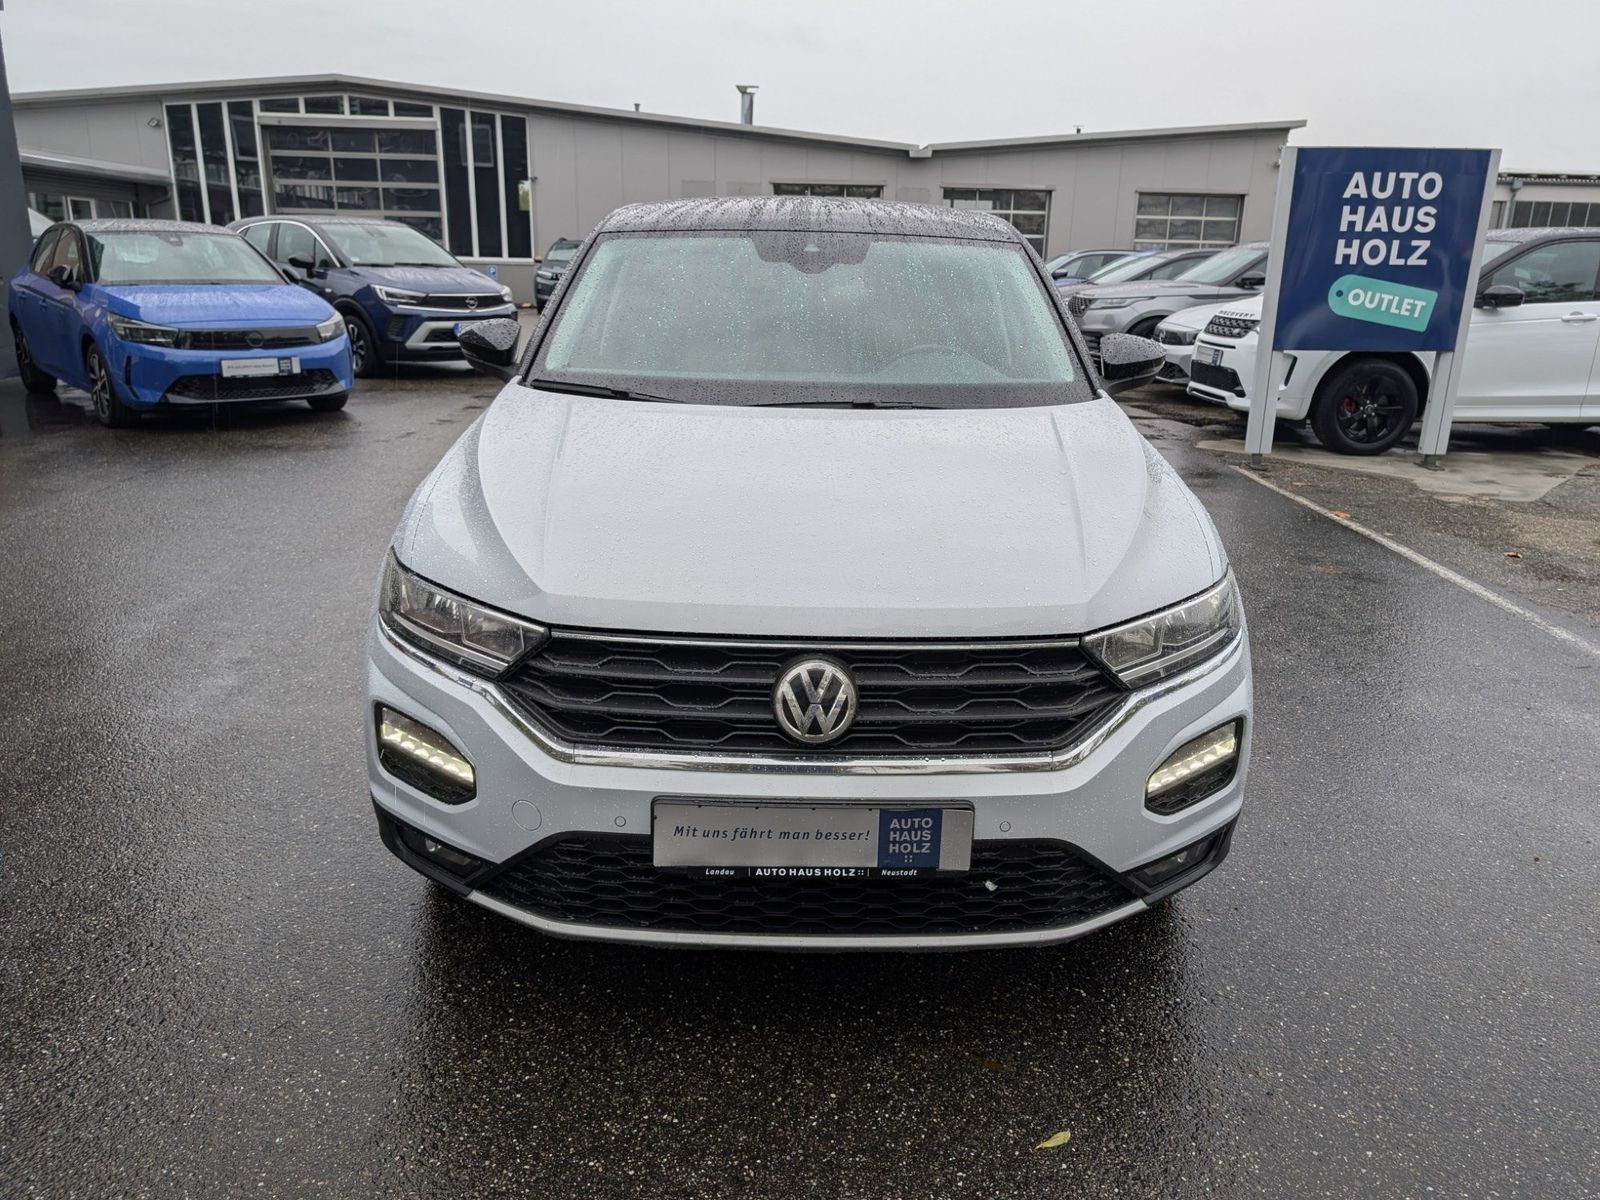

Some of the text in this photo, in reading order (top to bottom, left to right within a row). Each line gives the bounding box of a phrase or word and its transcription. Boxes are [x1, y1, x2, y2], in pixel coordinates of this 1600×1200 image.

[1342, 171, 1443, 201] AUTO
[1339, 205, 1438, 233] HAUS
[1334, 238, 1432, 266] HOLZ
[1347, 288, 1427, 318] OUTLET
[889, 817, 933, 829] AUTO
[673, 825, 871, 841] Mit uns fährt man besser!
[889, 830, 932, 841] HAUS
[888, 843, 931, 853] HOLZ
[705, 868, 735, 876] Landau
[755, 868, 856, 877] AUTO HAUS HOLZ
[881, 869, 918, 877] Neustadt
